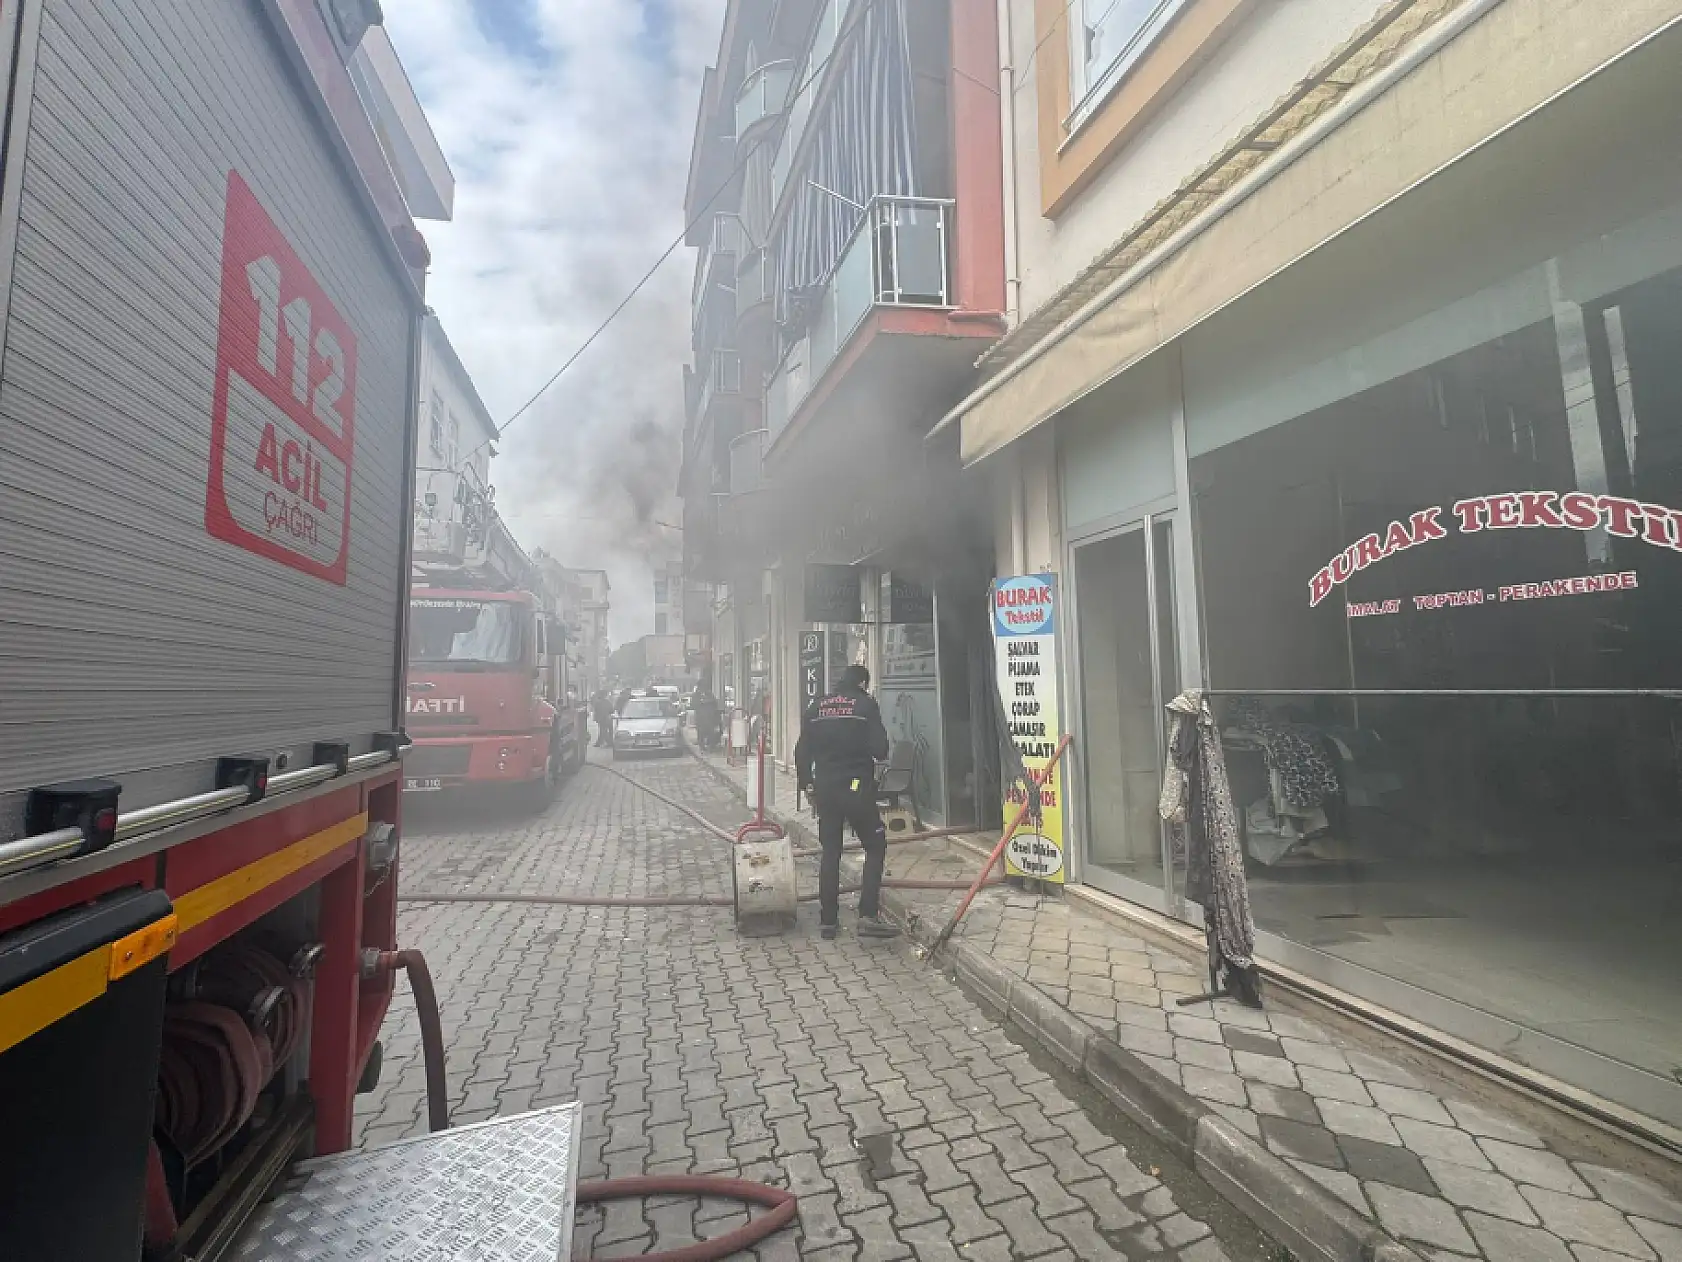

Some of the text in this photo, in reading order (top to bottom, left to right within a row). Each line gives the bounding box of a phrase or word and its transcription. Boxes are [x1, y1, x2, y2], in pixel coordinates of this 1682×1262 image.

[246, 255, 345, 440] 112
[254, 423, 328, 513] ACİL
[262, 490, 320, 546] ÇAĞRI
[1308, 506, 1447, 607] BURAK
[997, 586, 1052, 607] BURAK
[1413, 588, 1484, 610] TOPTAN
[1500, 570, 1638, 602] PERAKENDE
[1004, 609, 1044, 624] Tekstil
[1015, 682, 1035, 696] ETEK
